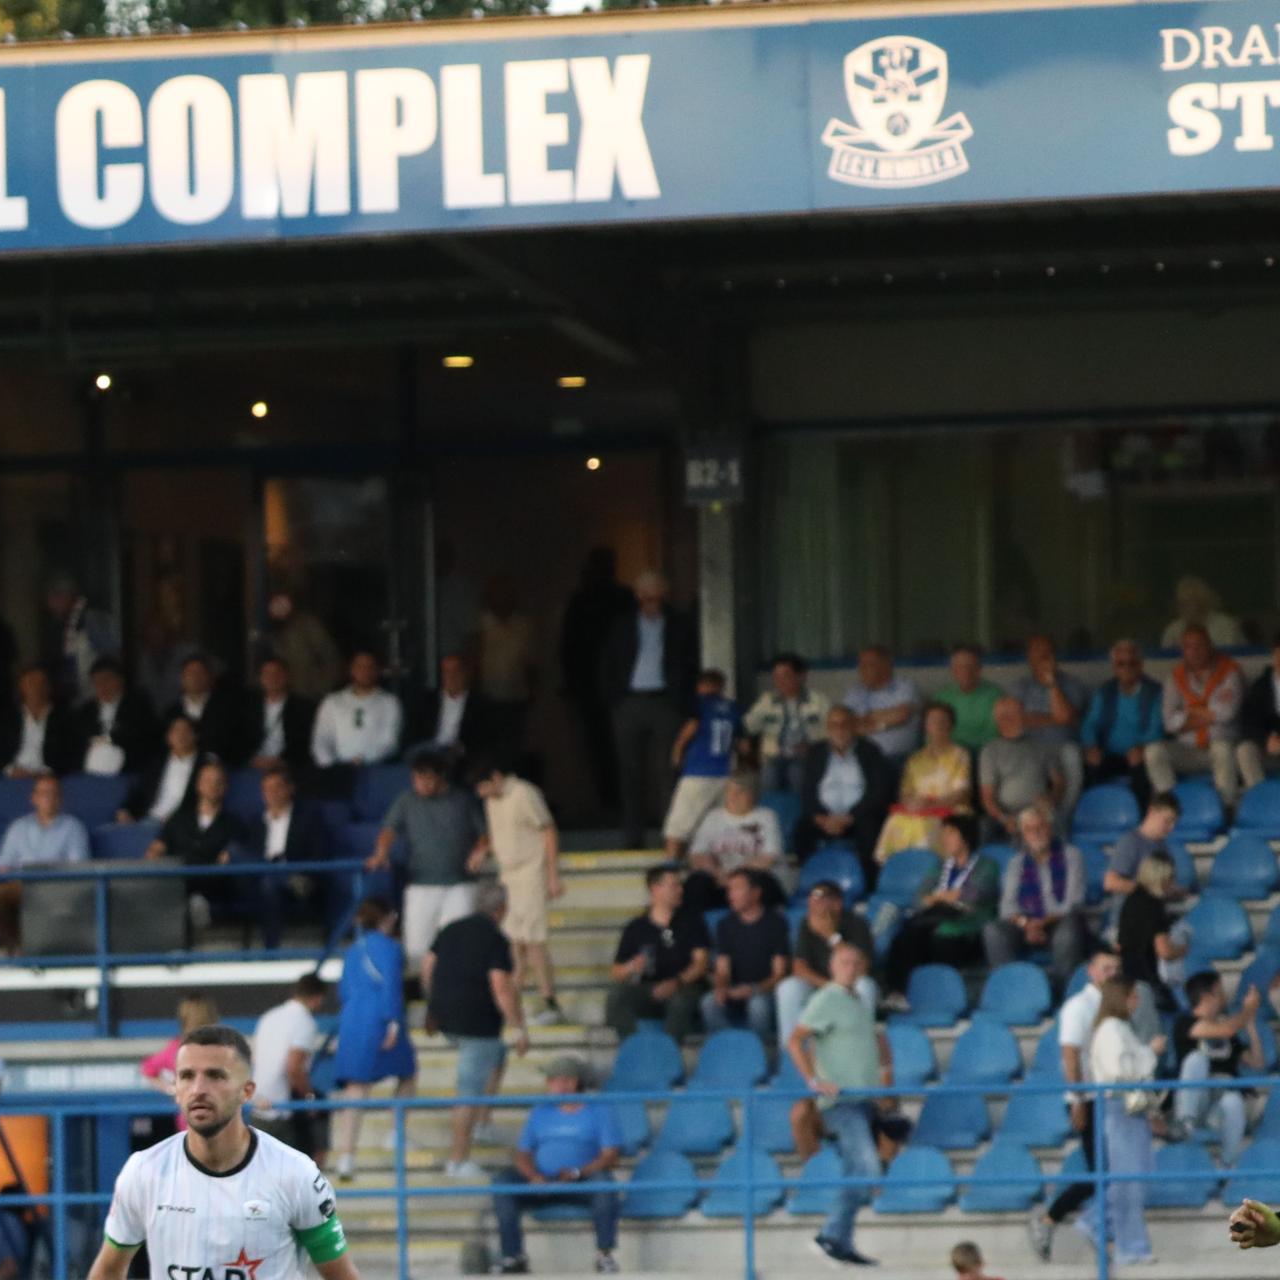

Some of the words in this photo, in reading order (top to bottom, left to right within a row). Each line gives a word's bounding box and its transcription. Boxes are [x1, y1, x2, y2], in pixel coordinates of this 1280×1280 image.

[1159, 23, 1280, 71] DRA
[54, 54, 661, 230] COMPLEX
[1167, 80, 1280, 157] ST
